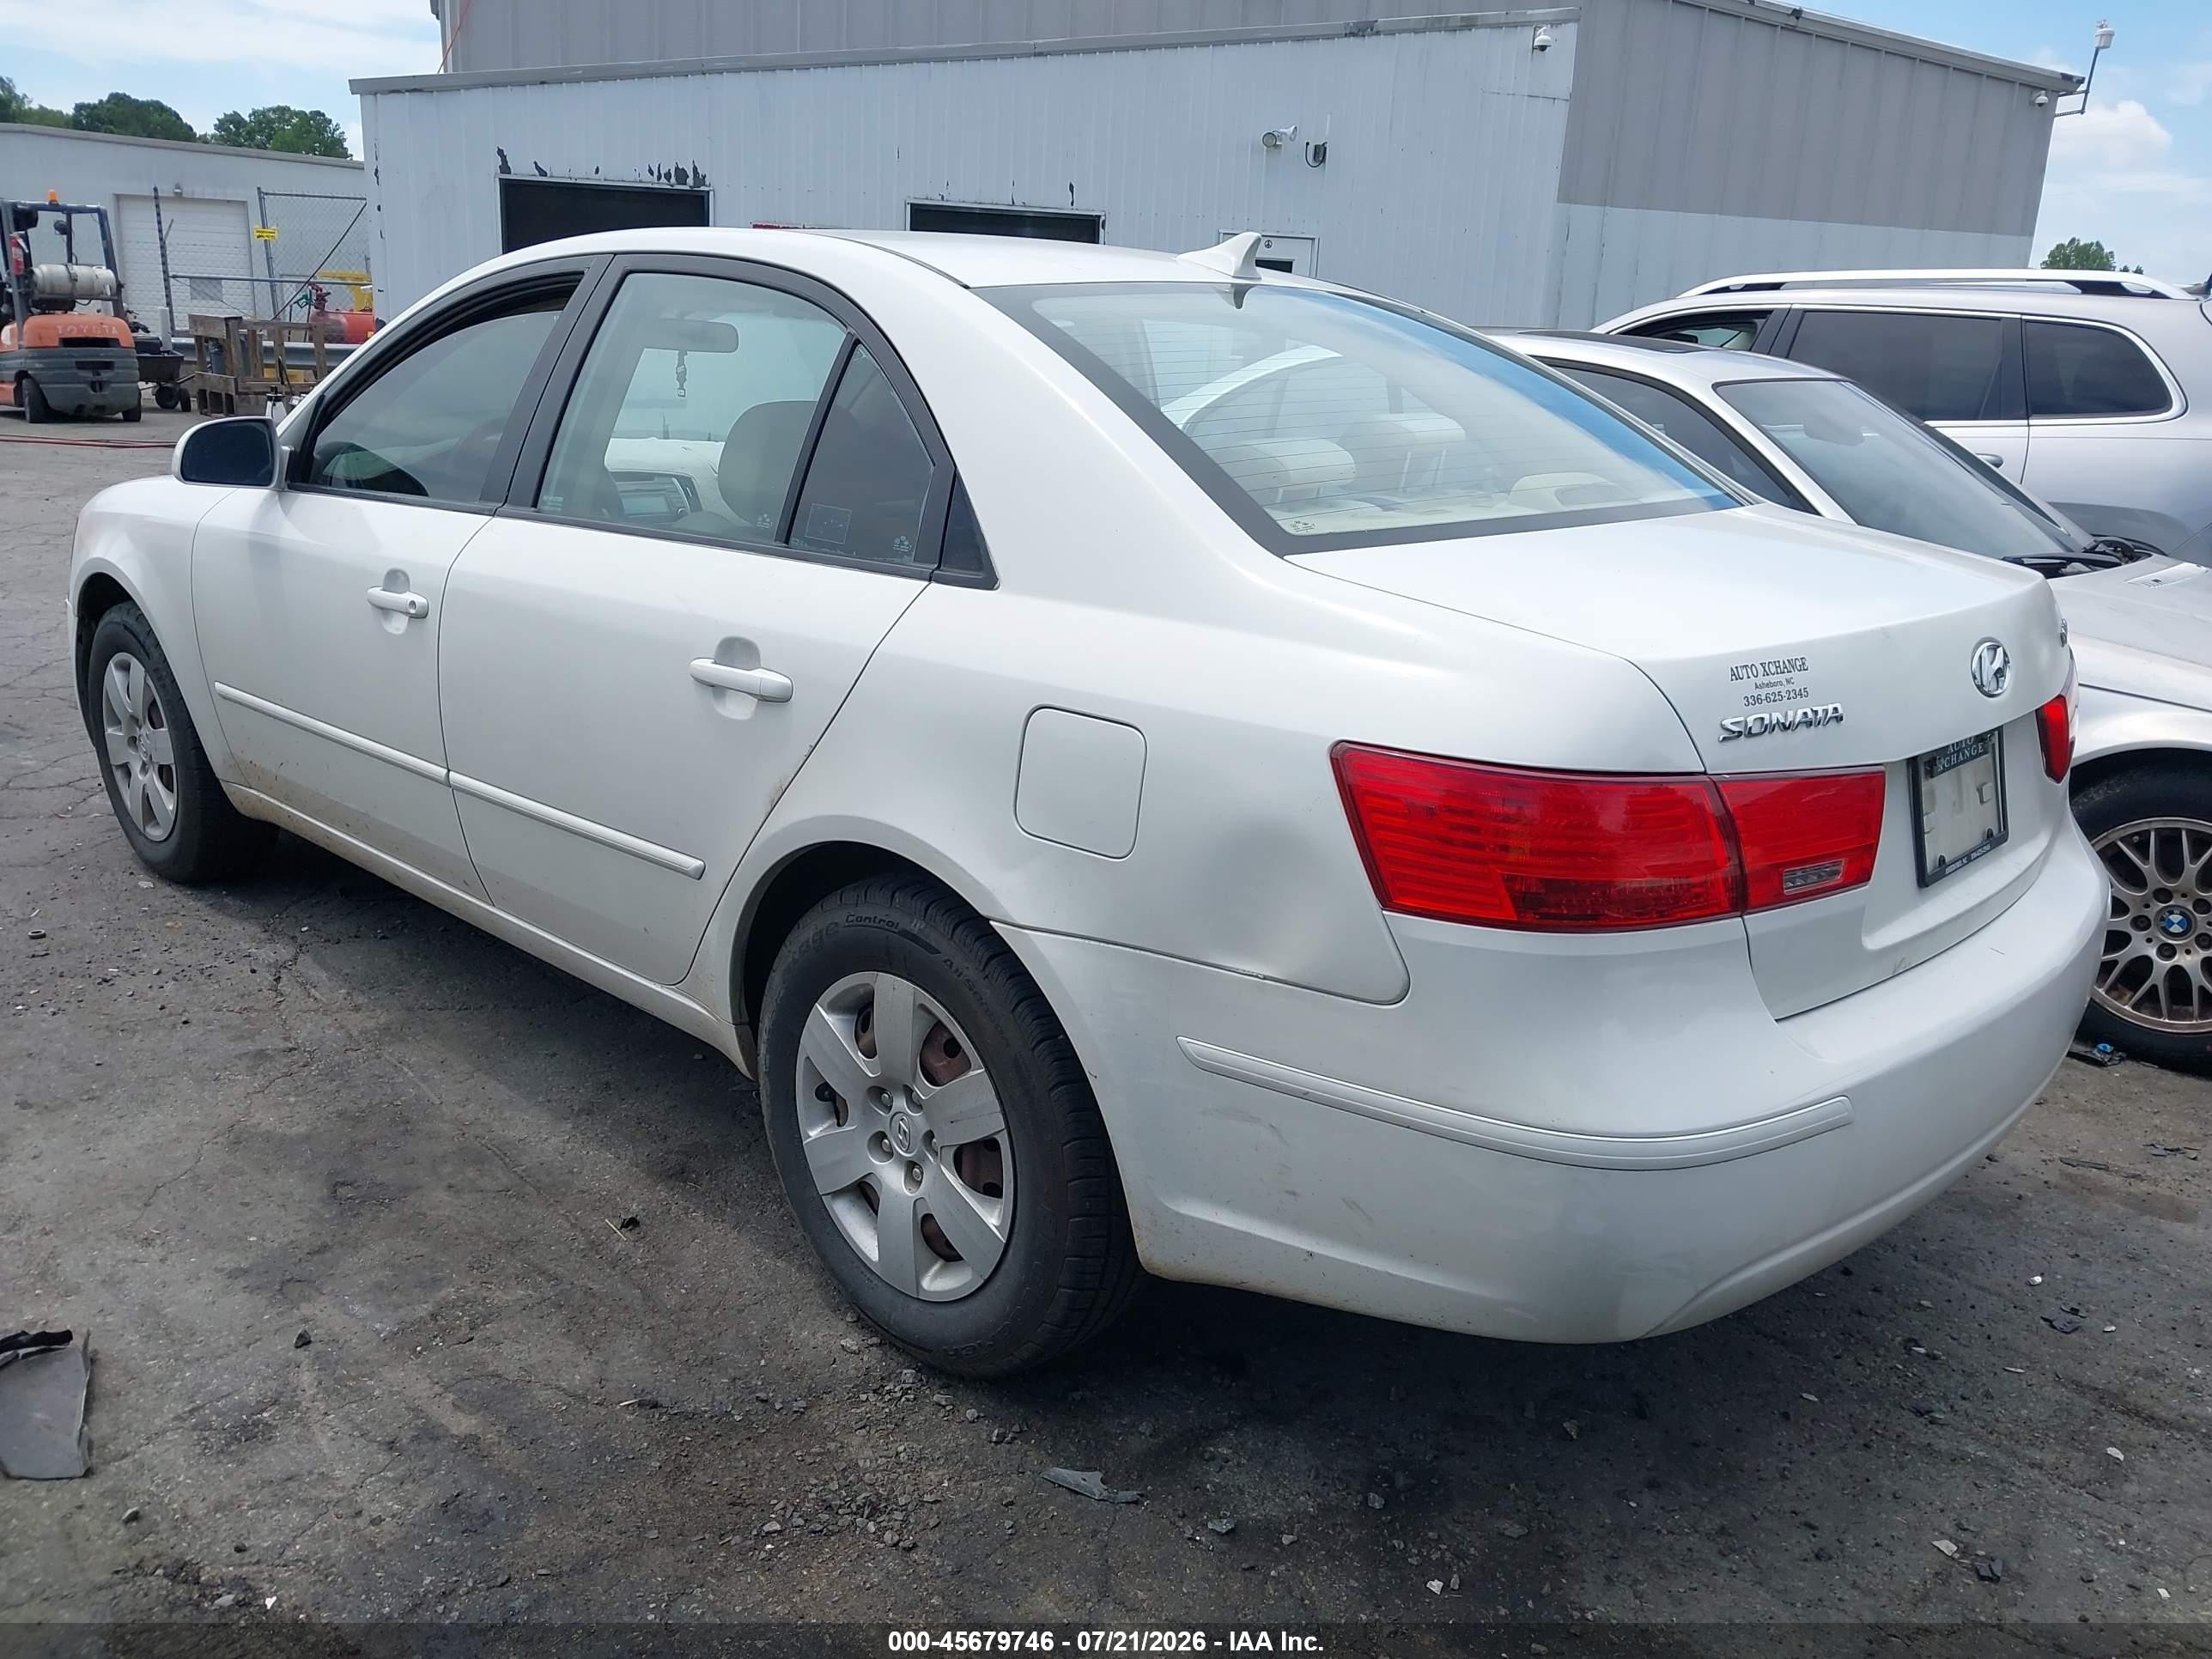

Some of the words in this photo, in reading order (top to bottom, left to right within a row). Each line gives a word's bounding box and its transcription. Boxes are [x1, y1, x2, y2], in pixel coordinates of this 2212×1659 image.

[55, 325, 118, 335] TOYOTA
[1730, 664, 1759, 681] AUTO
[1759, 657, 1808, 677] XCHANGE
[1754, 679, 1785, 690] Asheboro,
[1785, 677, 1795, 685] NC
[1743, 687, 1809, 707] 336-625-2345
[1718, 702, 1844, 743] SONATA
[846, 914, 899, 929] Control
